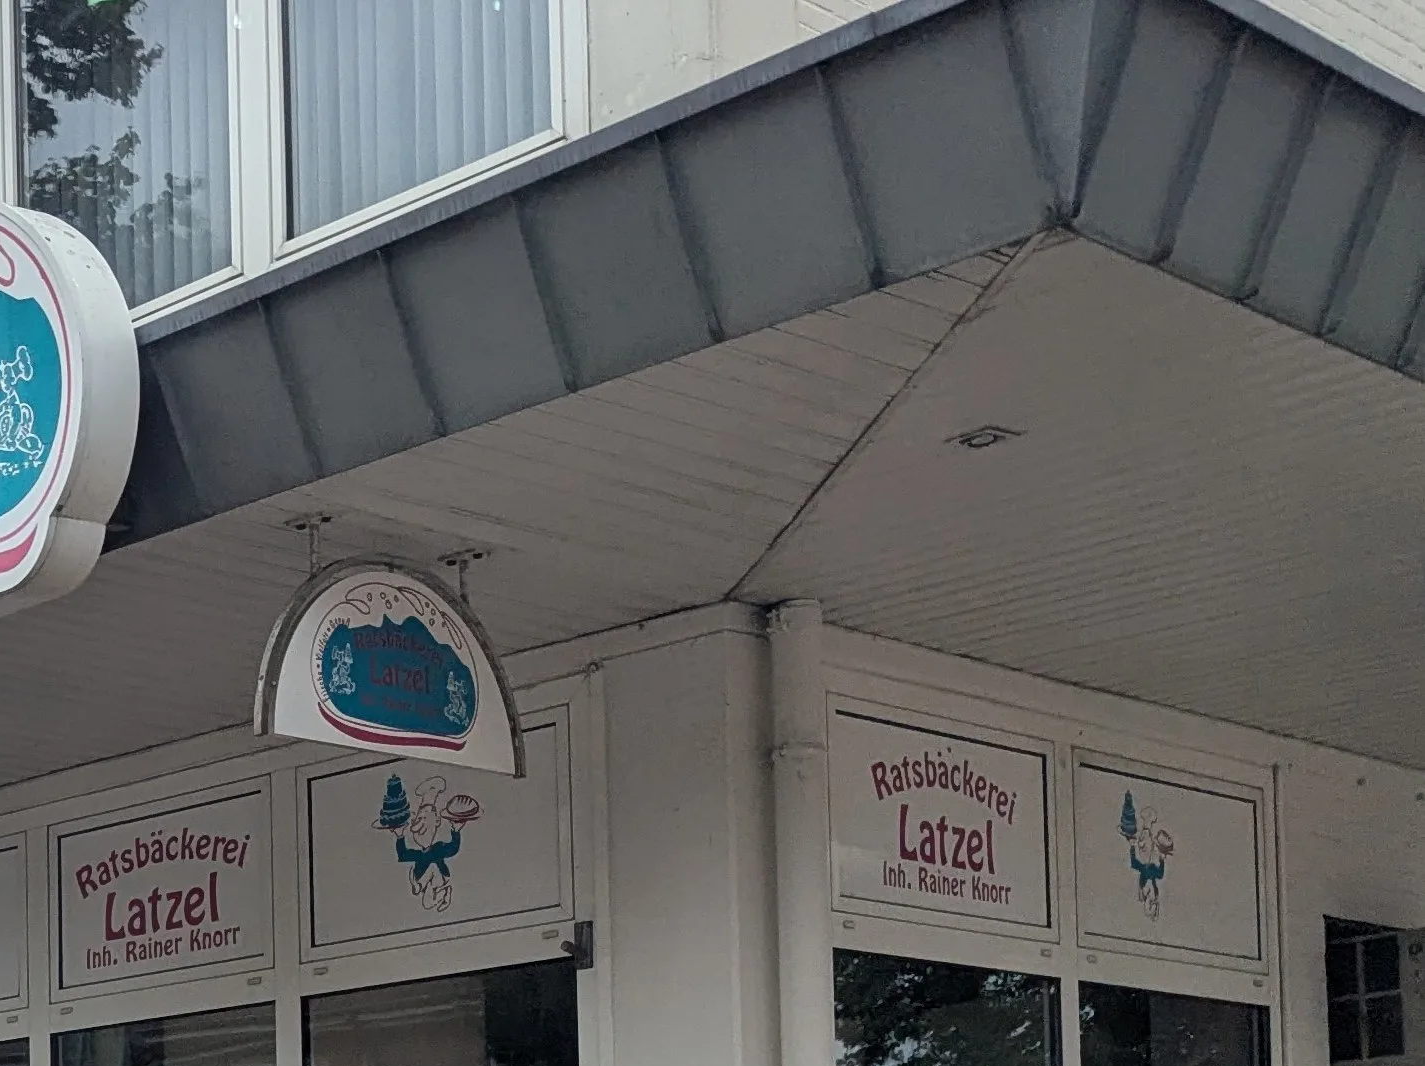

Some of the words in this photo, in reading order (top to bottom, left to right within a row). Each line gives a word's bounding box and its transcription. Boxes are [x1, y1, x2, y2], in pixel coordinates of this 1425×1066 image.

[870, 747, 1018, 825] Ratsbäckerei
[75, 827, 250, 900] Ratsbäckerei
[899, 803, 995, 875] Latzel
[104, 871, 220, 942] Latzel
[882, 860, 912, 890] Inh.
[918, 866, 966, 898] Rainer
[971, 875, 1012, 905] Knorr
[86, 946, 118, 970] Inh.
[125, 937, 183, 964] Rainer
[189, 926, 241, 952] Knorr
